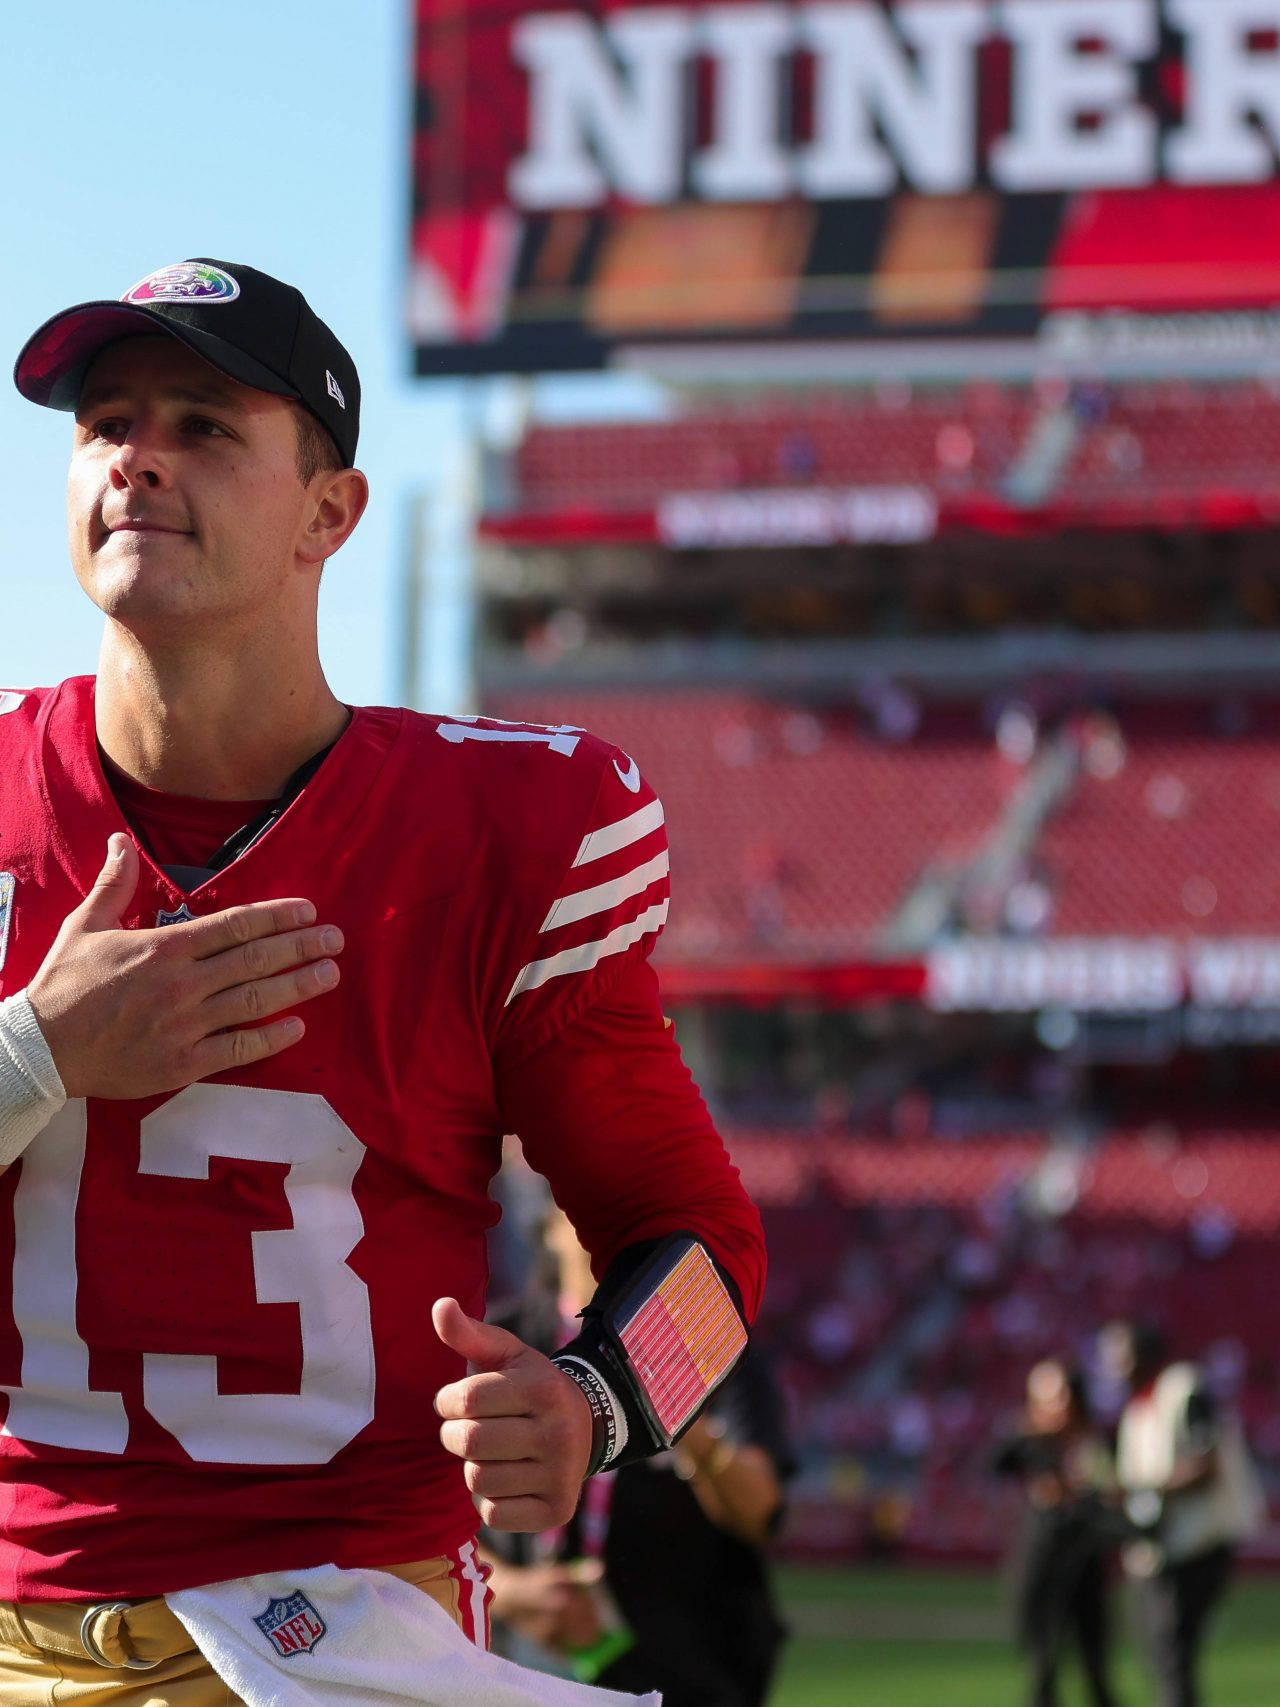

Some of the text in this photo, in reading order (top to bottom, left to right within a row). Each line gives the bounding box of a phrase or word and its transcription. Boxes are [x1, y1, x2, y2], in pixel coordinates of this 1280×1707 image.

[586, 1372, 613, 1417] AFRAID
[607, 1419, 616, 1436] BE
[603, 1440, 616, 1464] NOT
[271, 1612, 323, 1654] NFL
